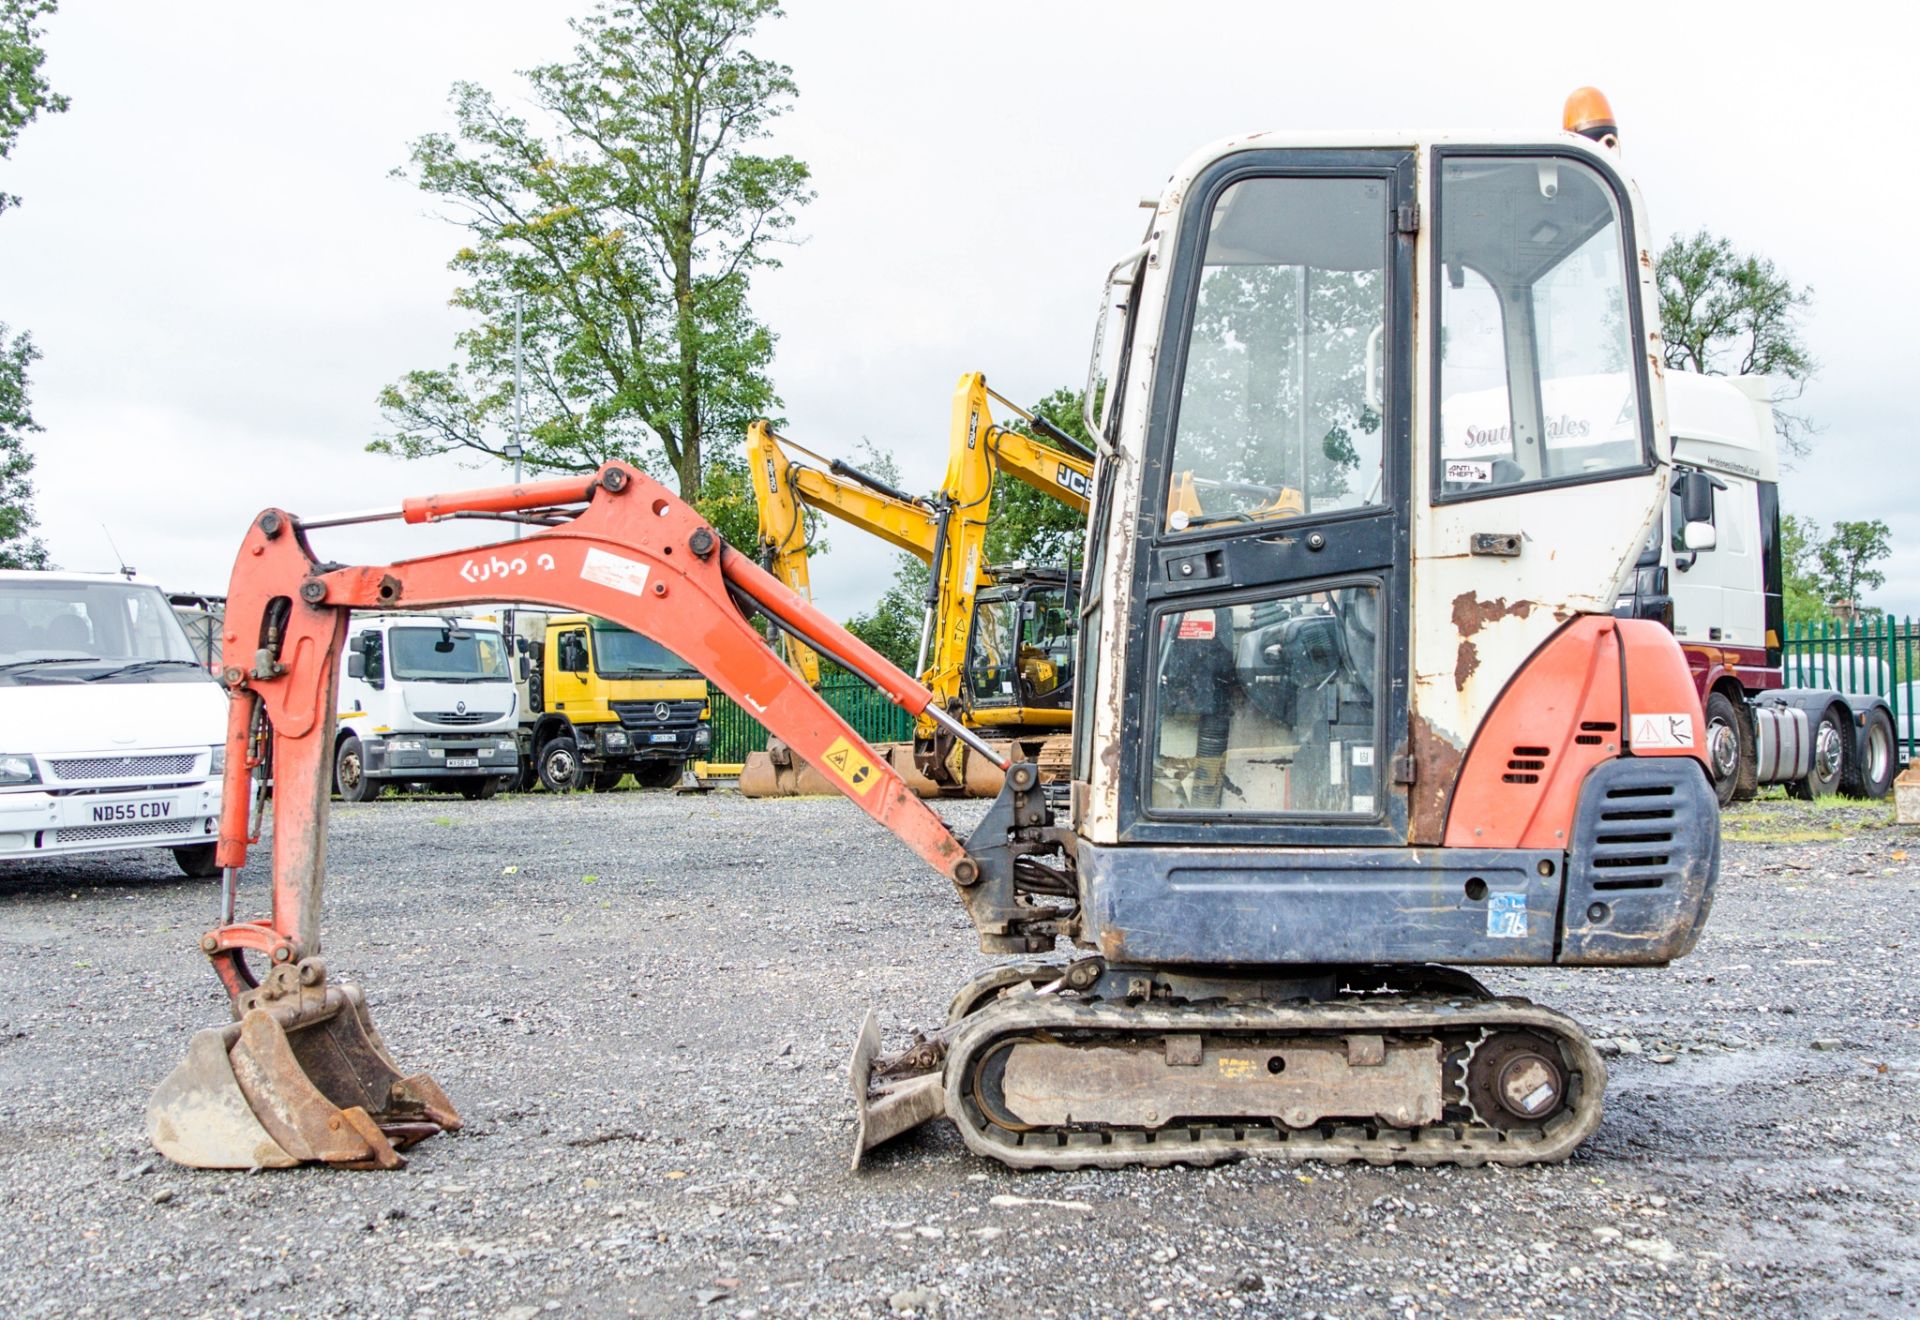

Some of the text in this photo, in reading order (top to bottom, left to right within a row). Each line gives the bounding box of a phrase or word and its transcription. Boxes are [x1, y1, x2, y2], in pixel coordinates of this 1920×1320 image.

[1544, 414, 1591, 438] ales
[93, 802, 170, 822] ND55 CDV
